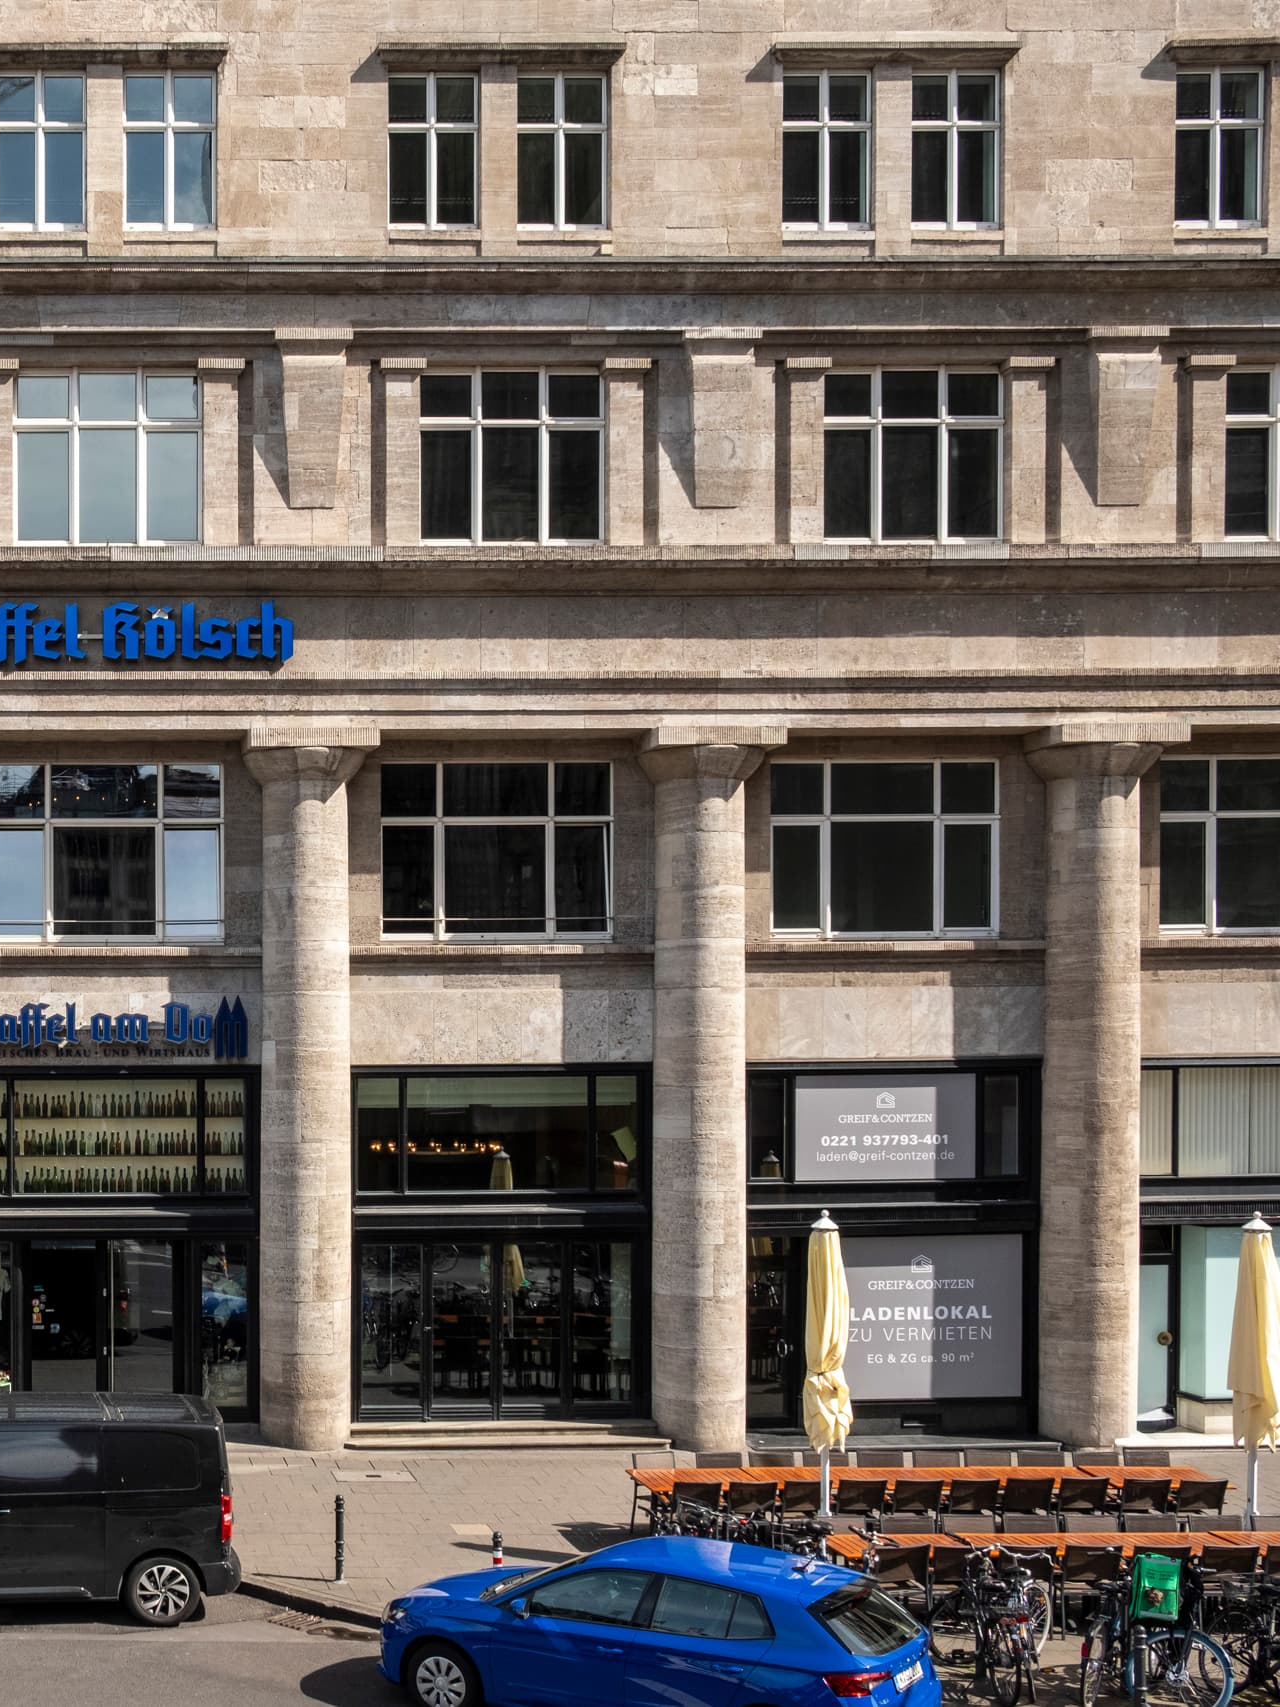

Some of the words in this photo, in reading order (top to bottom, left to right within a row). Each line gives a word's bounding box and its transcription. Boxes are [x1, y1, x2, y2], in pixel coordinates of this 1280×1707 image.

[102, 601, 294, 664] Kölsch
[90, 1013, 149, 1044] am
[838, 1113, 933, 1124] GREIF&CONTZEN
[821, 1135, 857, 1147] 0221
[863, 1134, 949, 1146] 937793-401
[816, 1150, 955, 1163] laden@greif-contzen.de
[868, 1278, 975, 1290] GREIF&CONTZEN
[850, 1305, 992, 1321] LADENLOKAL
[849, 1327, 872, 1342] ZU
[882, 1325, 992, 1341] VERMIETEN
[867, 1353, 883, 1364] EG
[887, 1353, 896, 1363] &
[900, 1353, 917, 1363] ZG
[921, 1353, 937, 1363] ca.
[941, 1352, 955, 1362] 90
